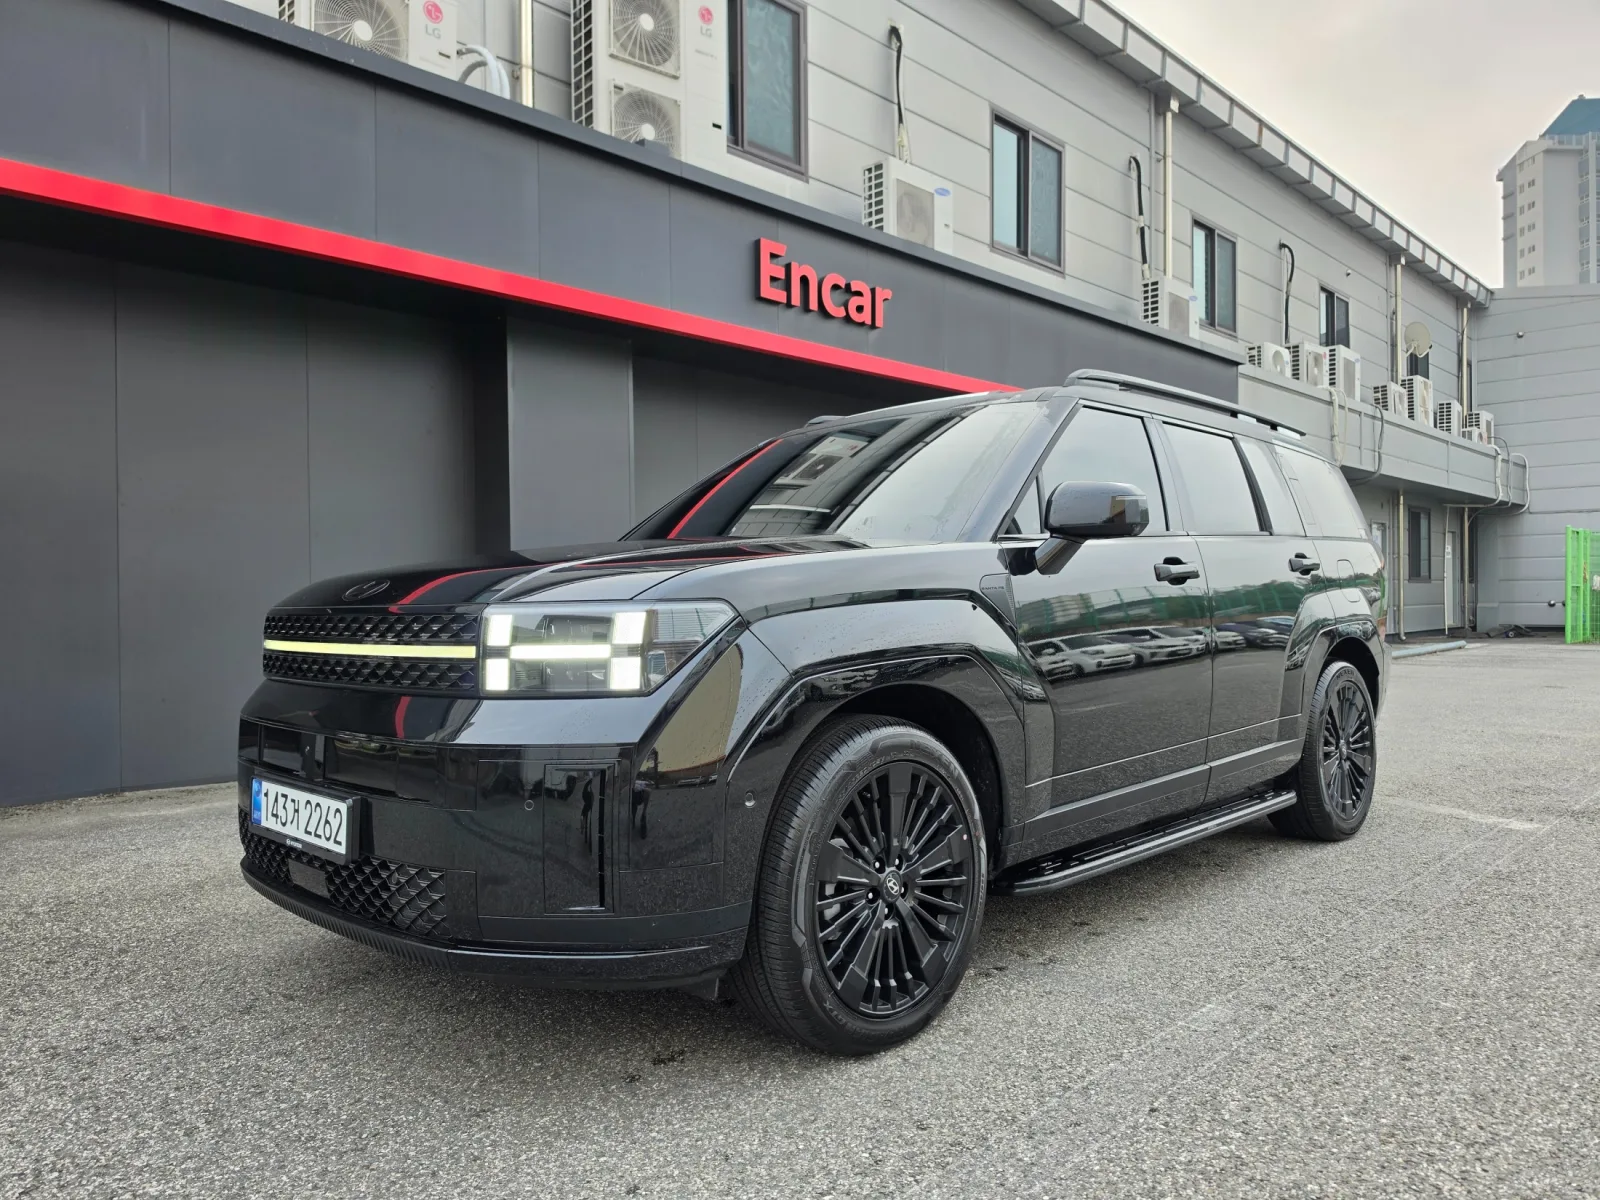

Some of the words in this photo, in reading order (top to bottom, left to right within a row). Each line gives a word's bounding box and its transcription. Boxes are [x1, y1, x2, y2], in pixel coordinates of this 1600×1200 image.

[425, 24, 441, 39] LG
[700, 25, 713, 38] LG
[758, 237, 892, 328] Encar
[263, 788, 300, 831] 143거
[304, 799, 343, 846] 2262
